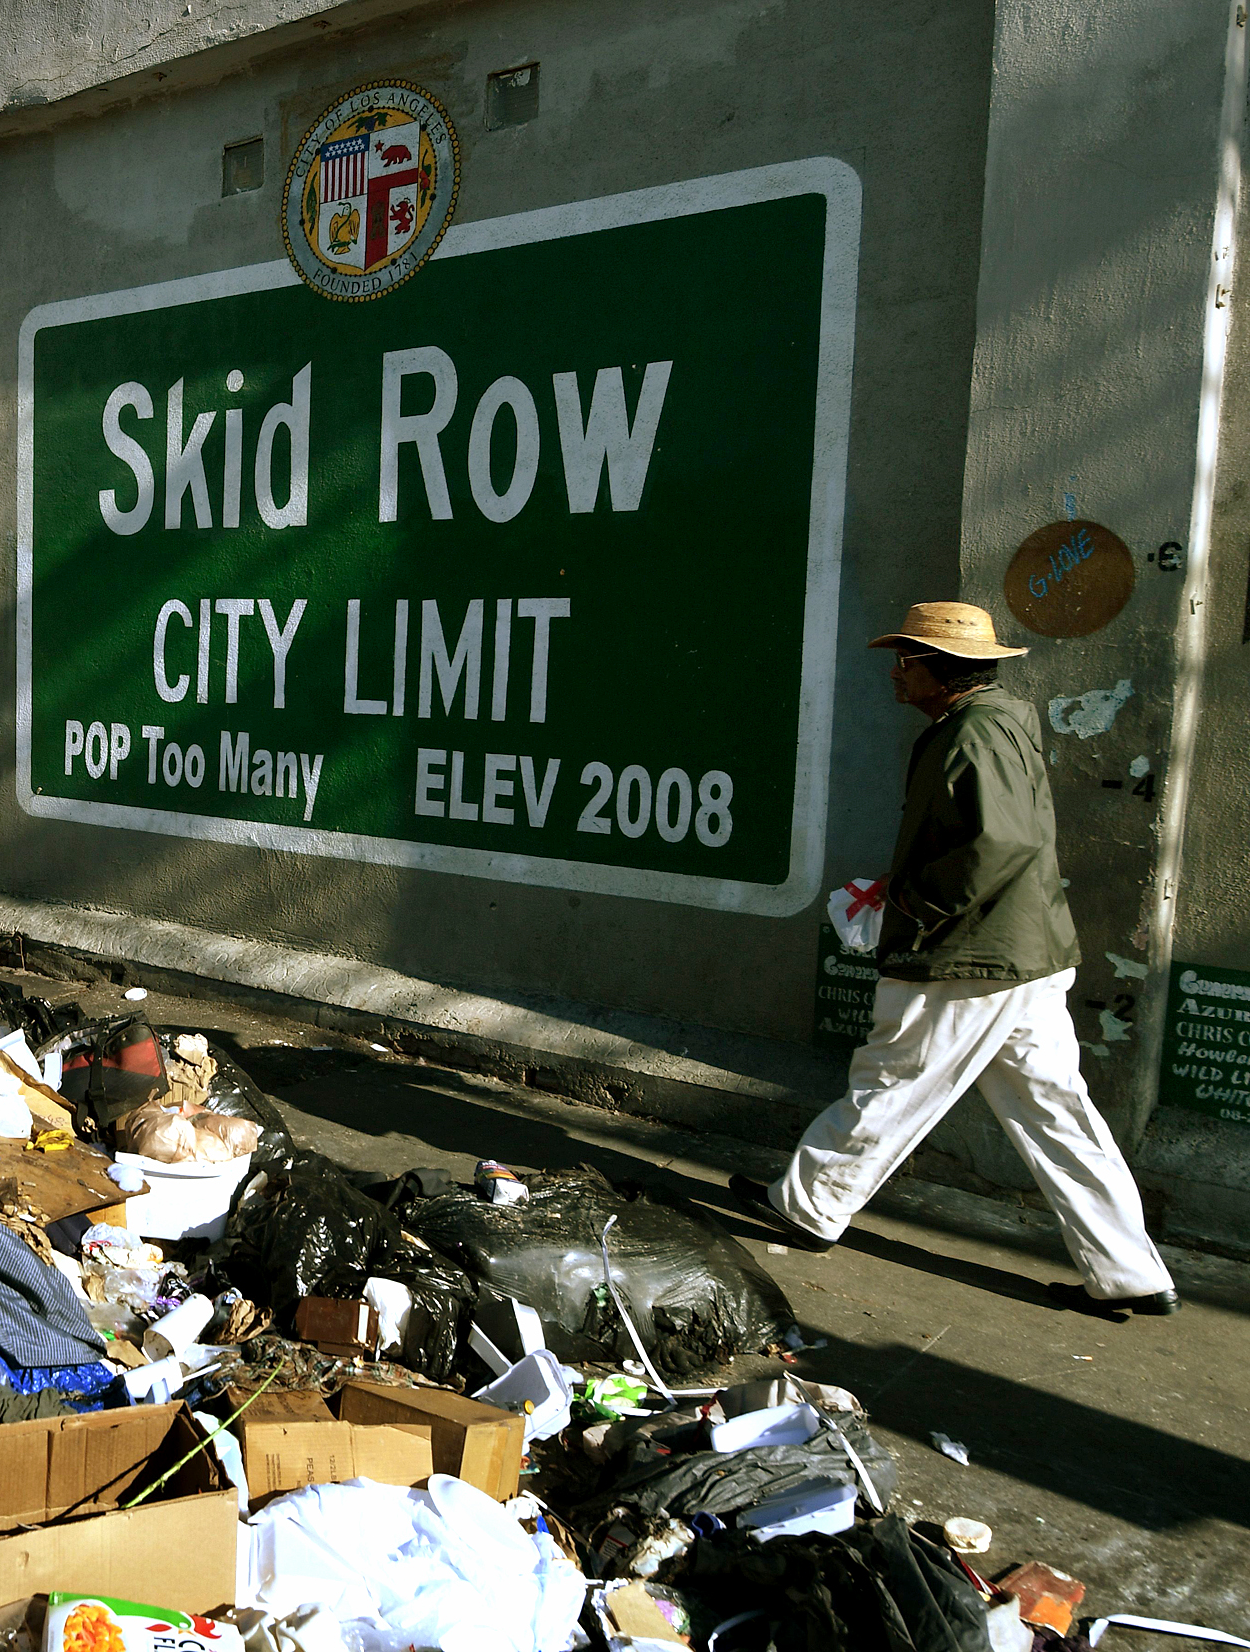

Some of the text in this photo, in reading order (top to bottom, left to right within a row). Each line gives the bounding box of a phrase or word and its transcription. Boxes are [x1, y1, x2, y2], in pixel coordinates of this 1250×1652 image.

[296, 91, 448, 178] CITY OF LOS ANGELES
[312, 252, 420, 295] FOUNDED 1781
[99, 345, 674, 537] Skid Row
[152, 597, 571, 724] CITY LIMIT
[64, 719, 734, 848] POP Too Many ELEV 2008
[818, 985, 860, 1004] CHRIS
[1175, 1021, 1234, 1044] CHRIS
[1172, 1063, 1224, 1082] WILD
[306, 1457, 315, 1483] PEAS
